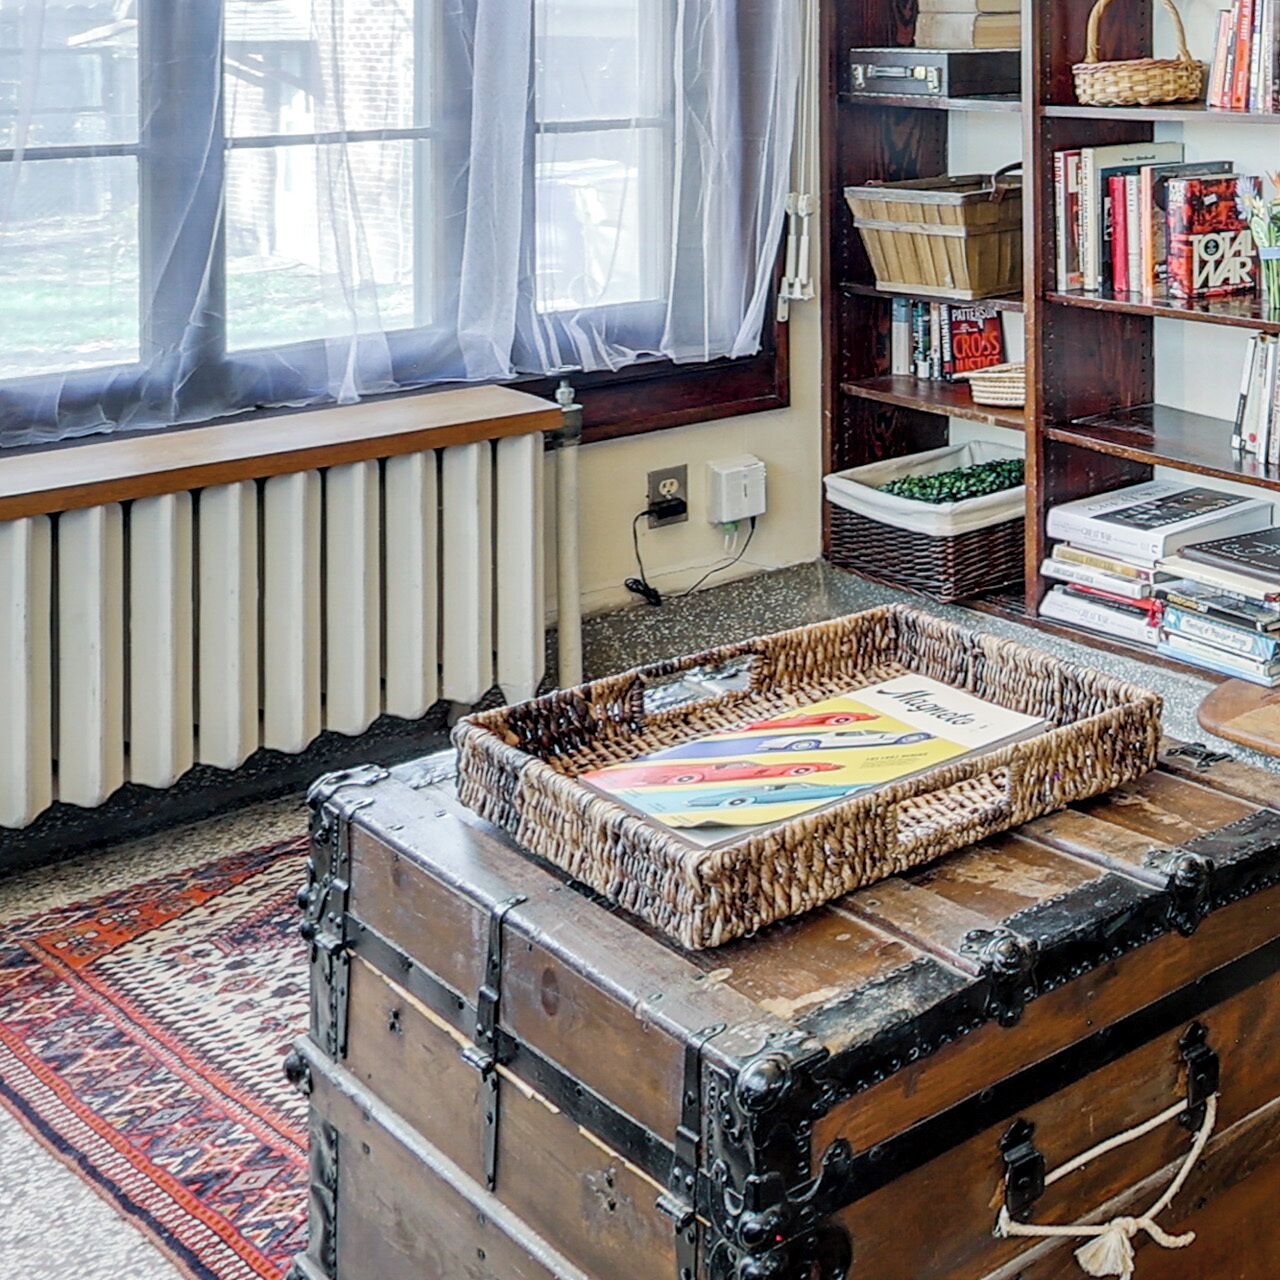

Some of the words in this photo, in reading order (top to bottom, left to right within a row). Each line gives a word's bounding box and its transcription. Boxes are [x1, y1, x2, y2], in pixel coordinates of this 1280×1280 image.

[1190, 230, 1256, 260] TOTAL
[1192, 256, 1254, 290] WAR
[952, 307, 997, 321] PATTERSON
[953, 330, 1000, 358] CROSS
[875, 690, 976, 726] Magneto
